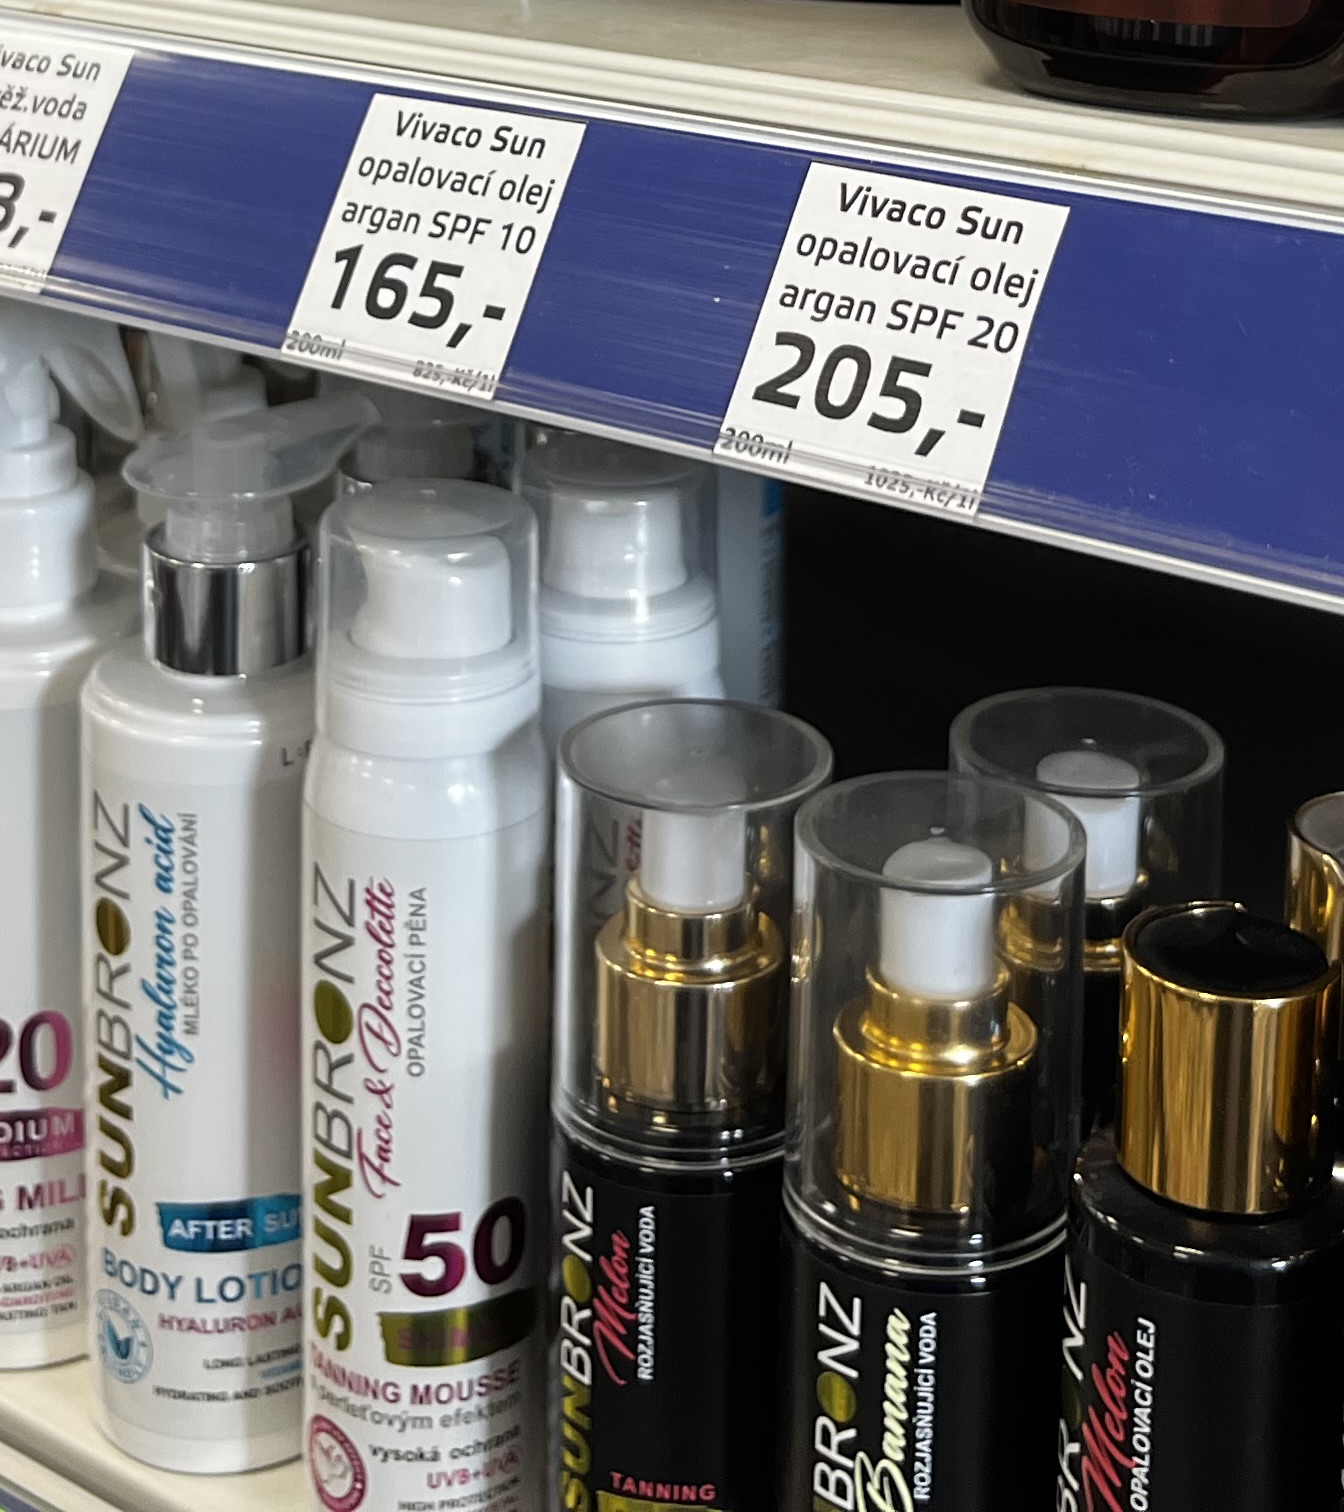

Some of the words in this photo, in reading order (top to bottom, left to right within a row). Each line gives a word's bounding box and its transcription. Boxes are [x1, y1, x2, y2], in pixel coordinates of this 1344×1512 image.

[57, 53, 102, 83] Sun
[395, 110, 482, 149] Vivaco
[490, 125, 547, 159] Sun
[358, 155, 497, 197] opalovací
[498, 174, 556, 214] olej
[839, 182, 946, 230] Vivaco
[956, 205, 1025, 245] Sun
[341, 201, 421, 234] argan
[428, 210, 492, 245] SPF
[501, 222, 536, 255] 10
[331, 244, 507, 349] 165,-
[796, 232, 967, 285] opalovací
[969, 262, 1040, 309] olej
[779, 283, 876, 325] argan
[886, 300, 964, 340] SPF
[967, 315, 1020, 354] 20
[752, 330, 986, 458] 205,-
[409, 888, 427, 949] PĚNA
[404, 953, 427, 1078] OPALOVACÍ
[167, 1217, 253, 1241] AFTER
[400, 1196, 525, 1297] 50
[368, 1245, 393, 1294] SPF
[594, 1230, 636, 1385] Melon
[919, 1311, 938, 1365] VODA
[1134, 1318, 1156, 1379] OLEJ
[410, 1359, 520, 1405] MOUSSE
[610, 1471, 716, 1501] TANNING
